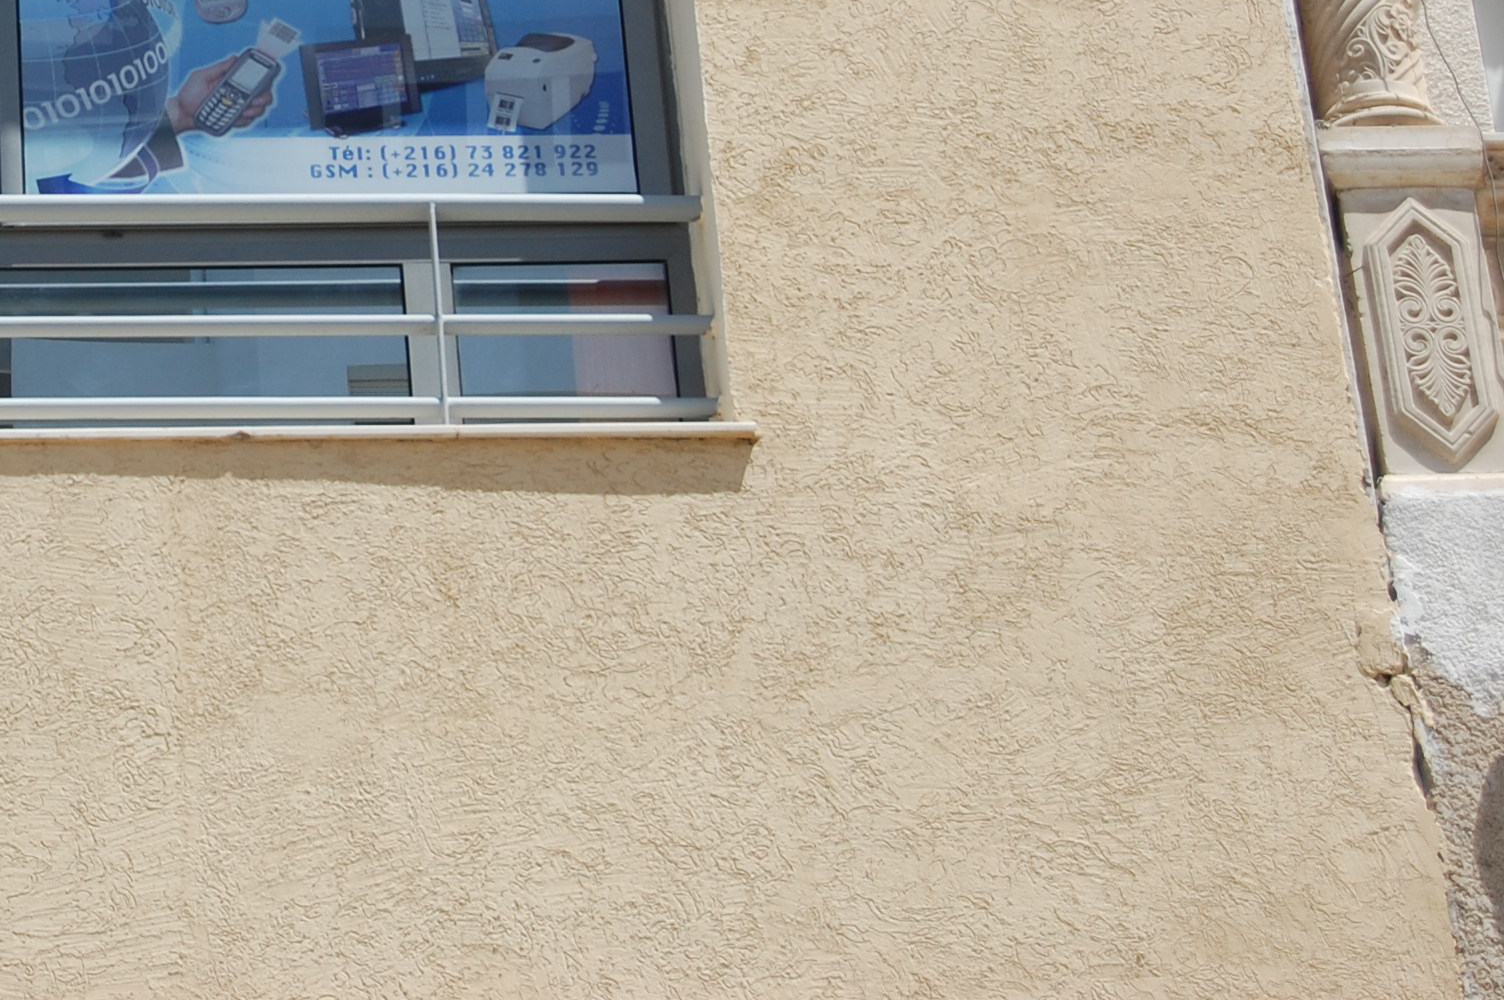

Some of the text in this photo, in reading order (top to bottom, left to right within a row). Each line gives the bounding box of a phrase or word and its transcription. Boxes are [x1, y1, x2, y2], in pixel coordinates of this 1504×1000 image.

[329, 143, 597, 161] Tél: (+216) 73 821 922
[310, 163, 358, 179] GSM
[382, 162, 458, 180] (+216)
[468, 162, 494, 178] 24
[504, 162, 547, 178] 278
[558, 161, 599, 177] 129
